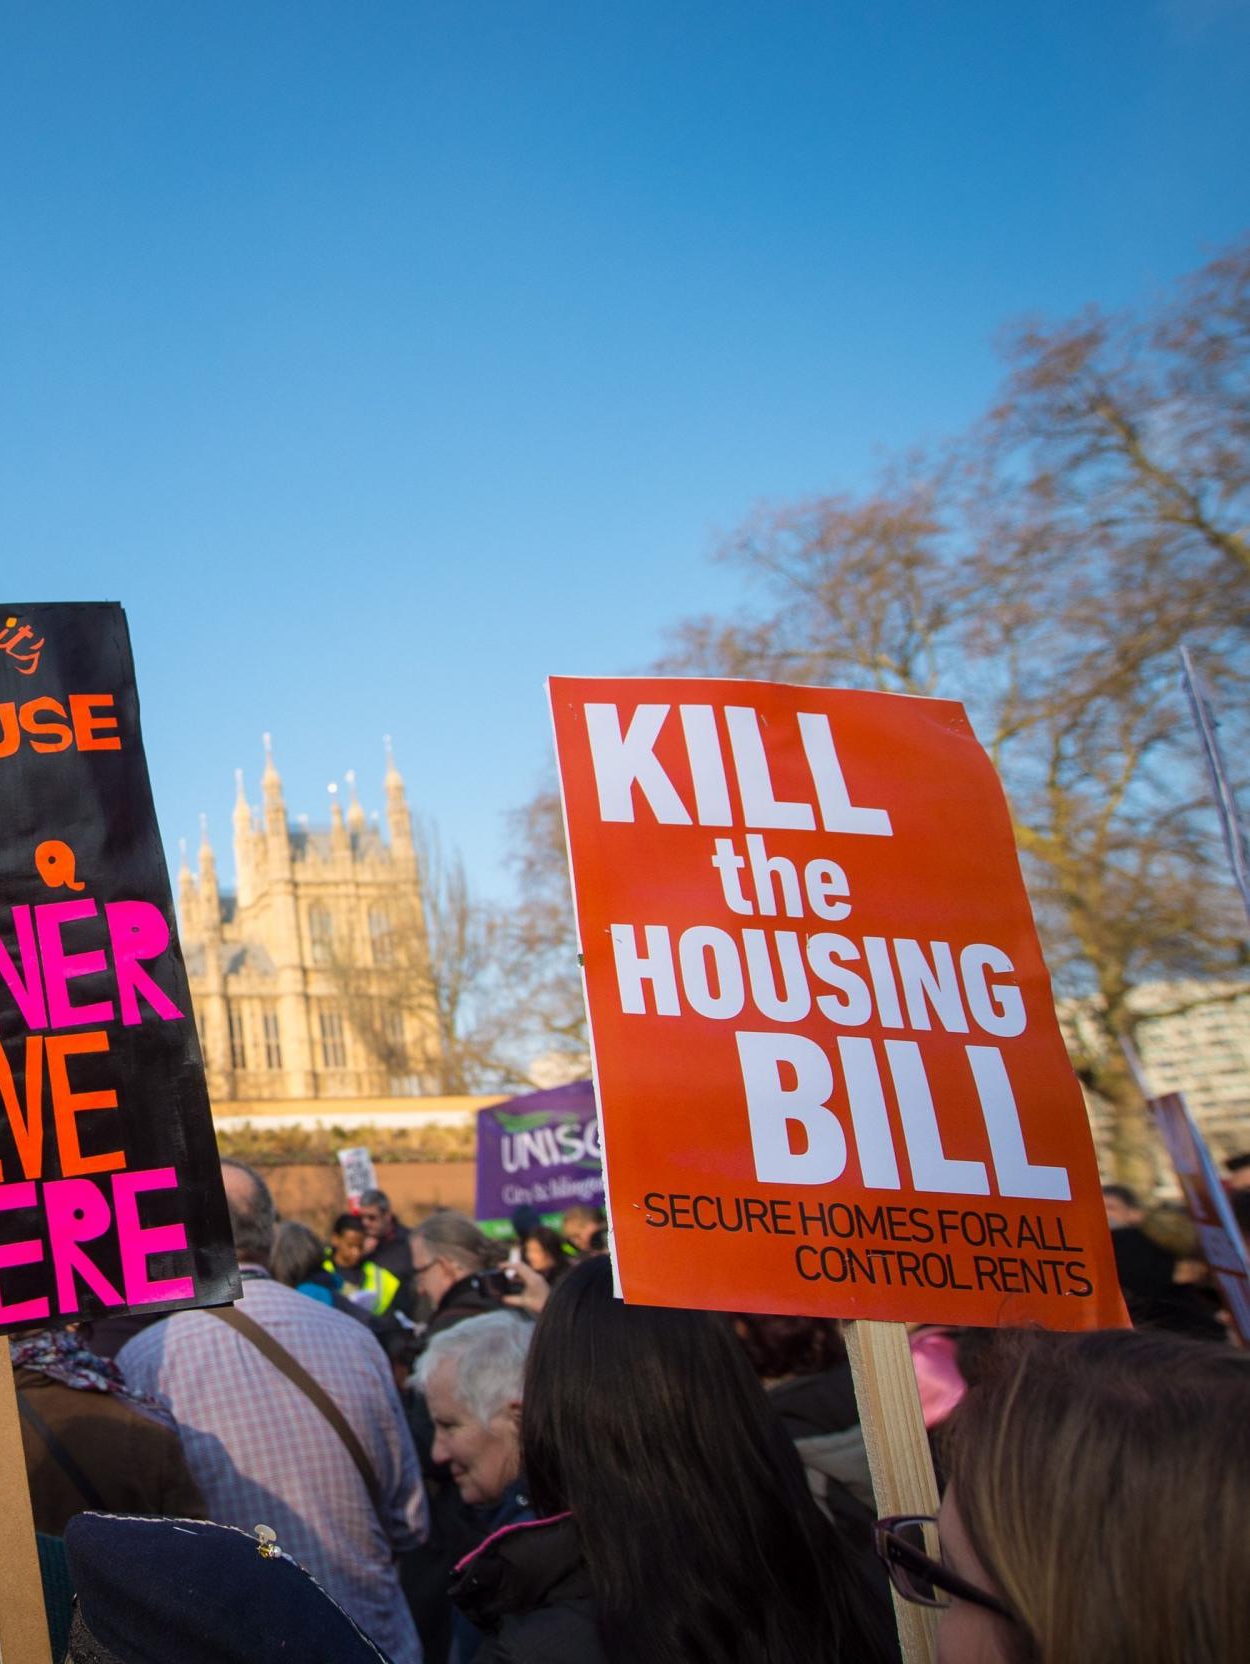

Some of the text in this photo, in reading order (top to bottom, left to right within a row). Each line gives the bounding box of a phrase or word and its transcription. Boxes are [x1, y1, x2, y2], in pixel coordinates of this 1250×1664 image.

[584, 703, 893, 836] KILL
[712, 834, 851, 921] the
[610, 924, 1026, 1038] HOUSING
[735, 1030, 1072, 1201] BILL
[645, 1192, 1084, 1254] SECURE HOMES FOR ALL
[795, 1245, 1093, 1298] CONTROL RENTS
